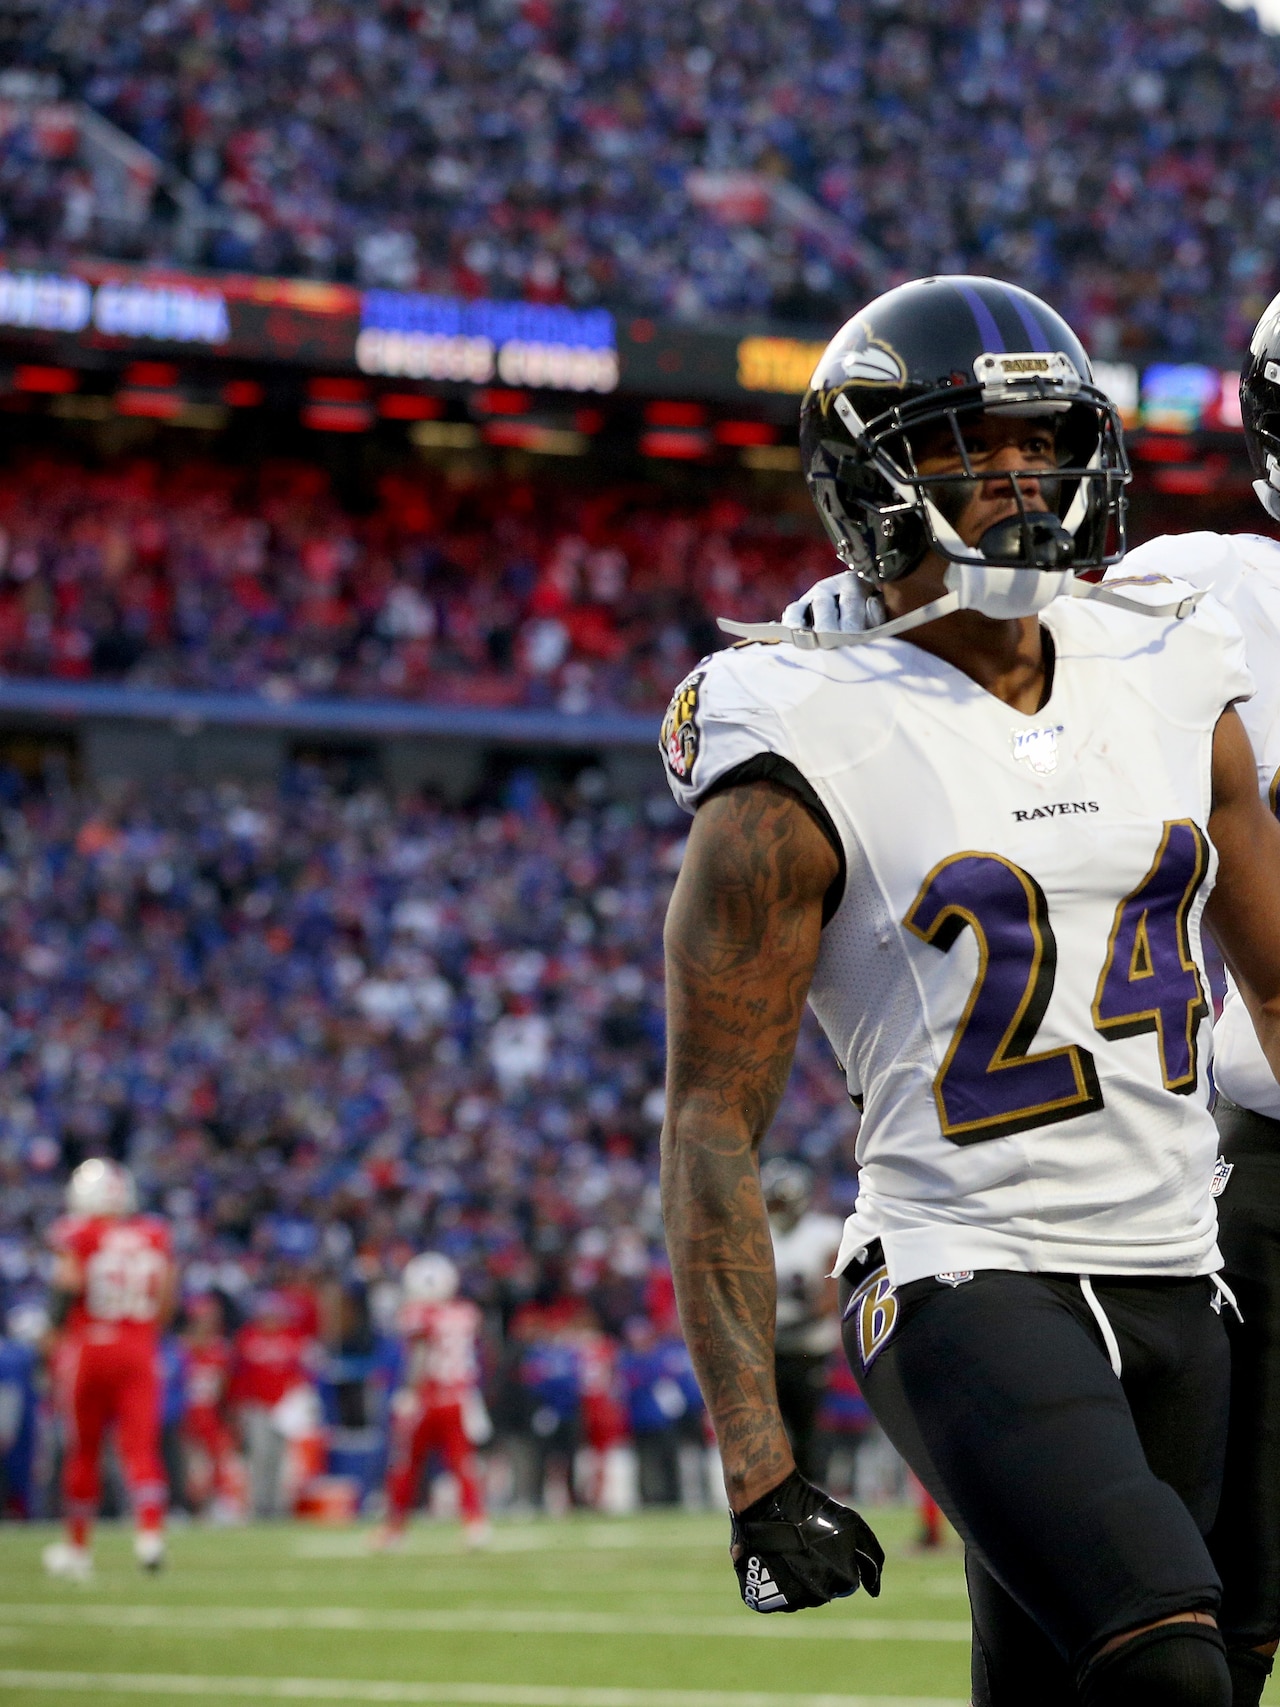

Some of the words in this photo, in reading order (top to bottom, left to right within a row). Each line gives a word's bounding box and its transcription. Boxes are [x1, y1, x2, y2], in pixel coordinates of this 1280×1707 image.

[1012, 801, 1100, 822] RAVENS
[902, 818, 1209, 1147] 24
[744, 1556, 761, 1610] adida
